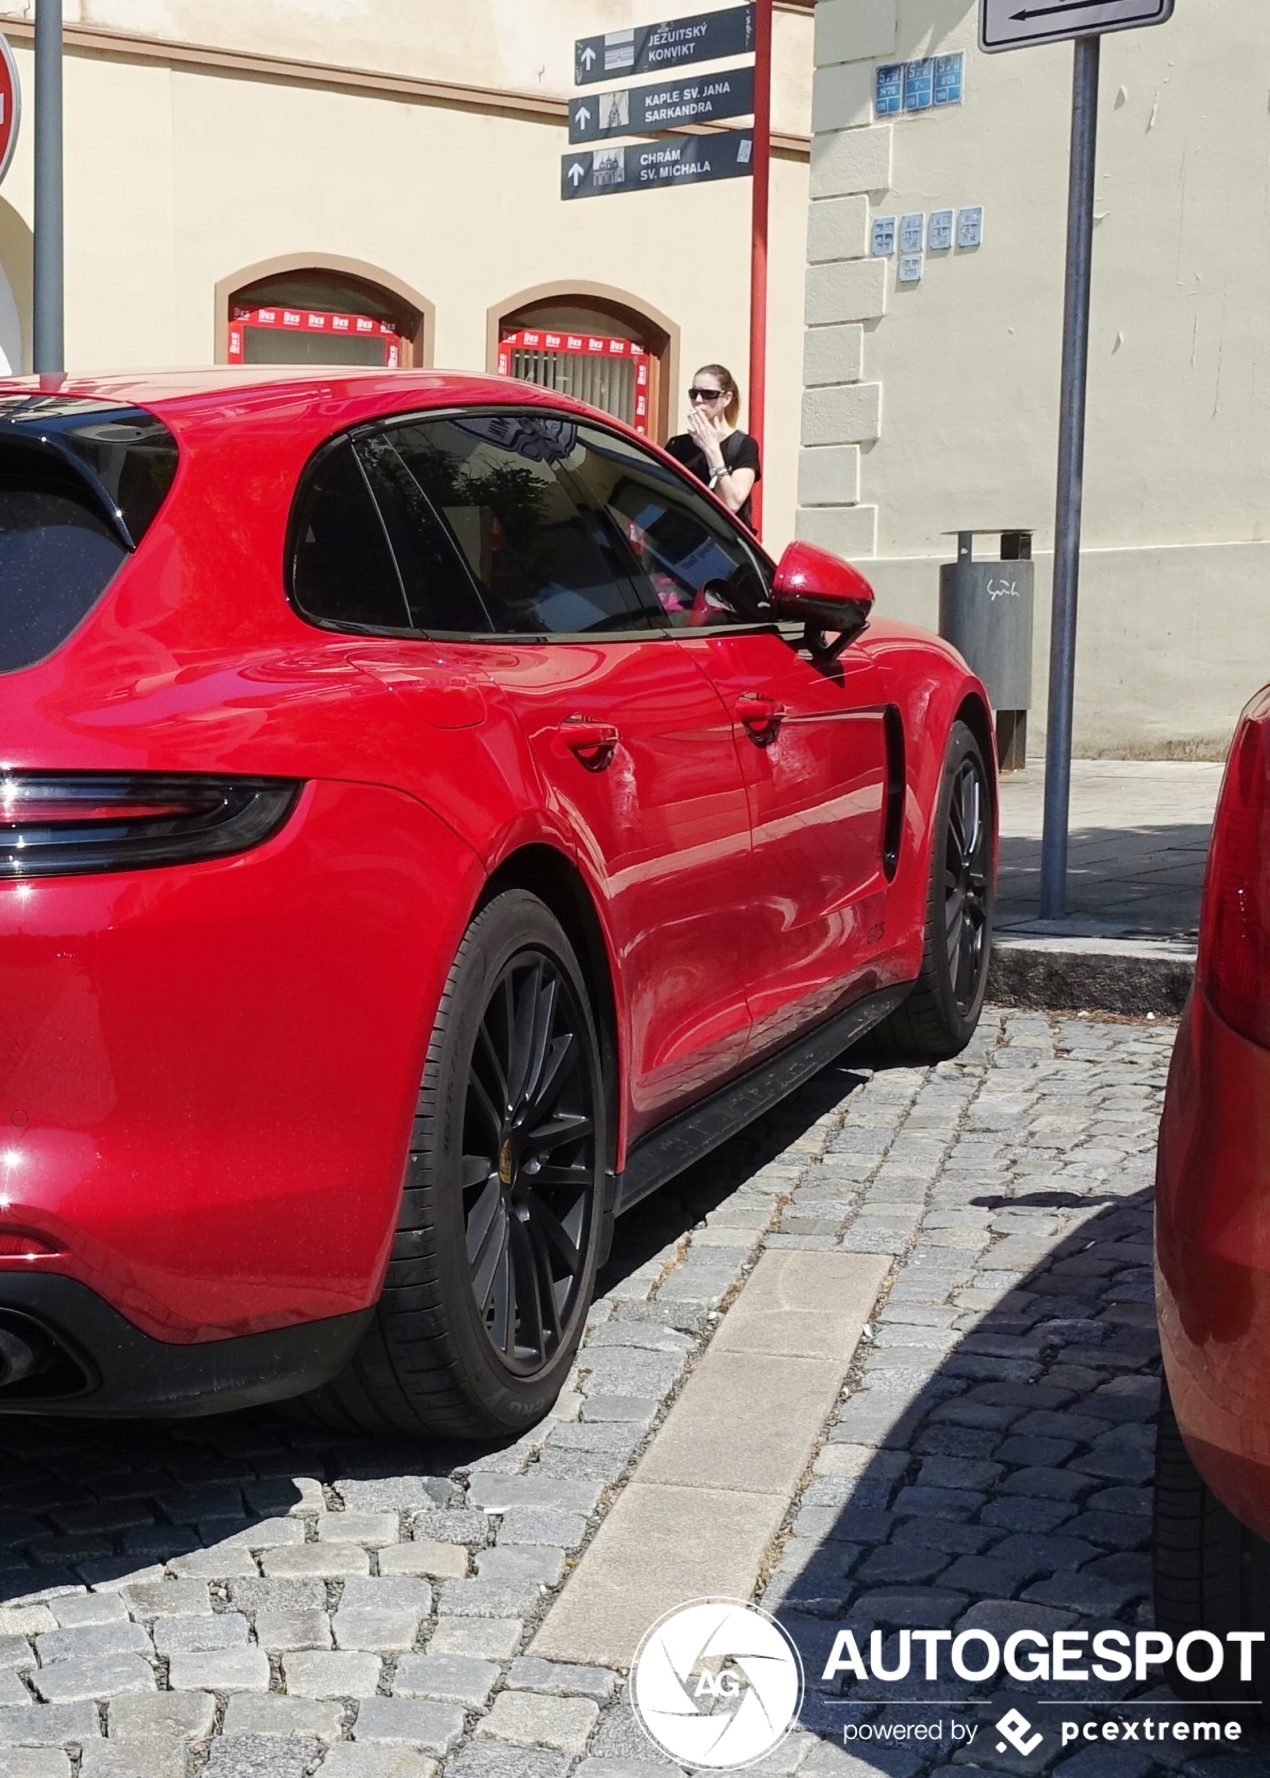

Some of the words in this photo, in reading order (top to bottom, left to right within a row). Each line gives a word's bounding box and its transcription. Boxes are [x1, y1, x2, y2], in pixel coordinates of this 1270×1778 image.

[648, 22, 708, 47] JEZUITSKÝ
[648, 42, 696, 63] KONVIKT
[645, 90, 680, 107] KAPLE
[683, 87, 700, 101] SV.
[702, 81, 731, 98] JANA
[645, 101, 713, 123] SARKANDRA
[640, 148, 681, 166] CHRÁM
[640, 168, 657, 181] SV.
[659, 160, 711, 178] MICHALA
